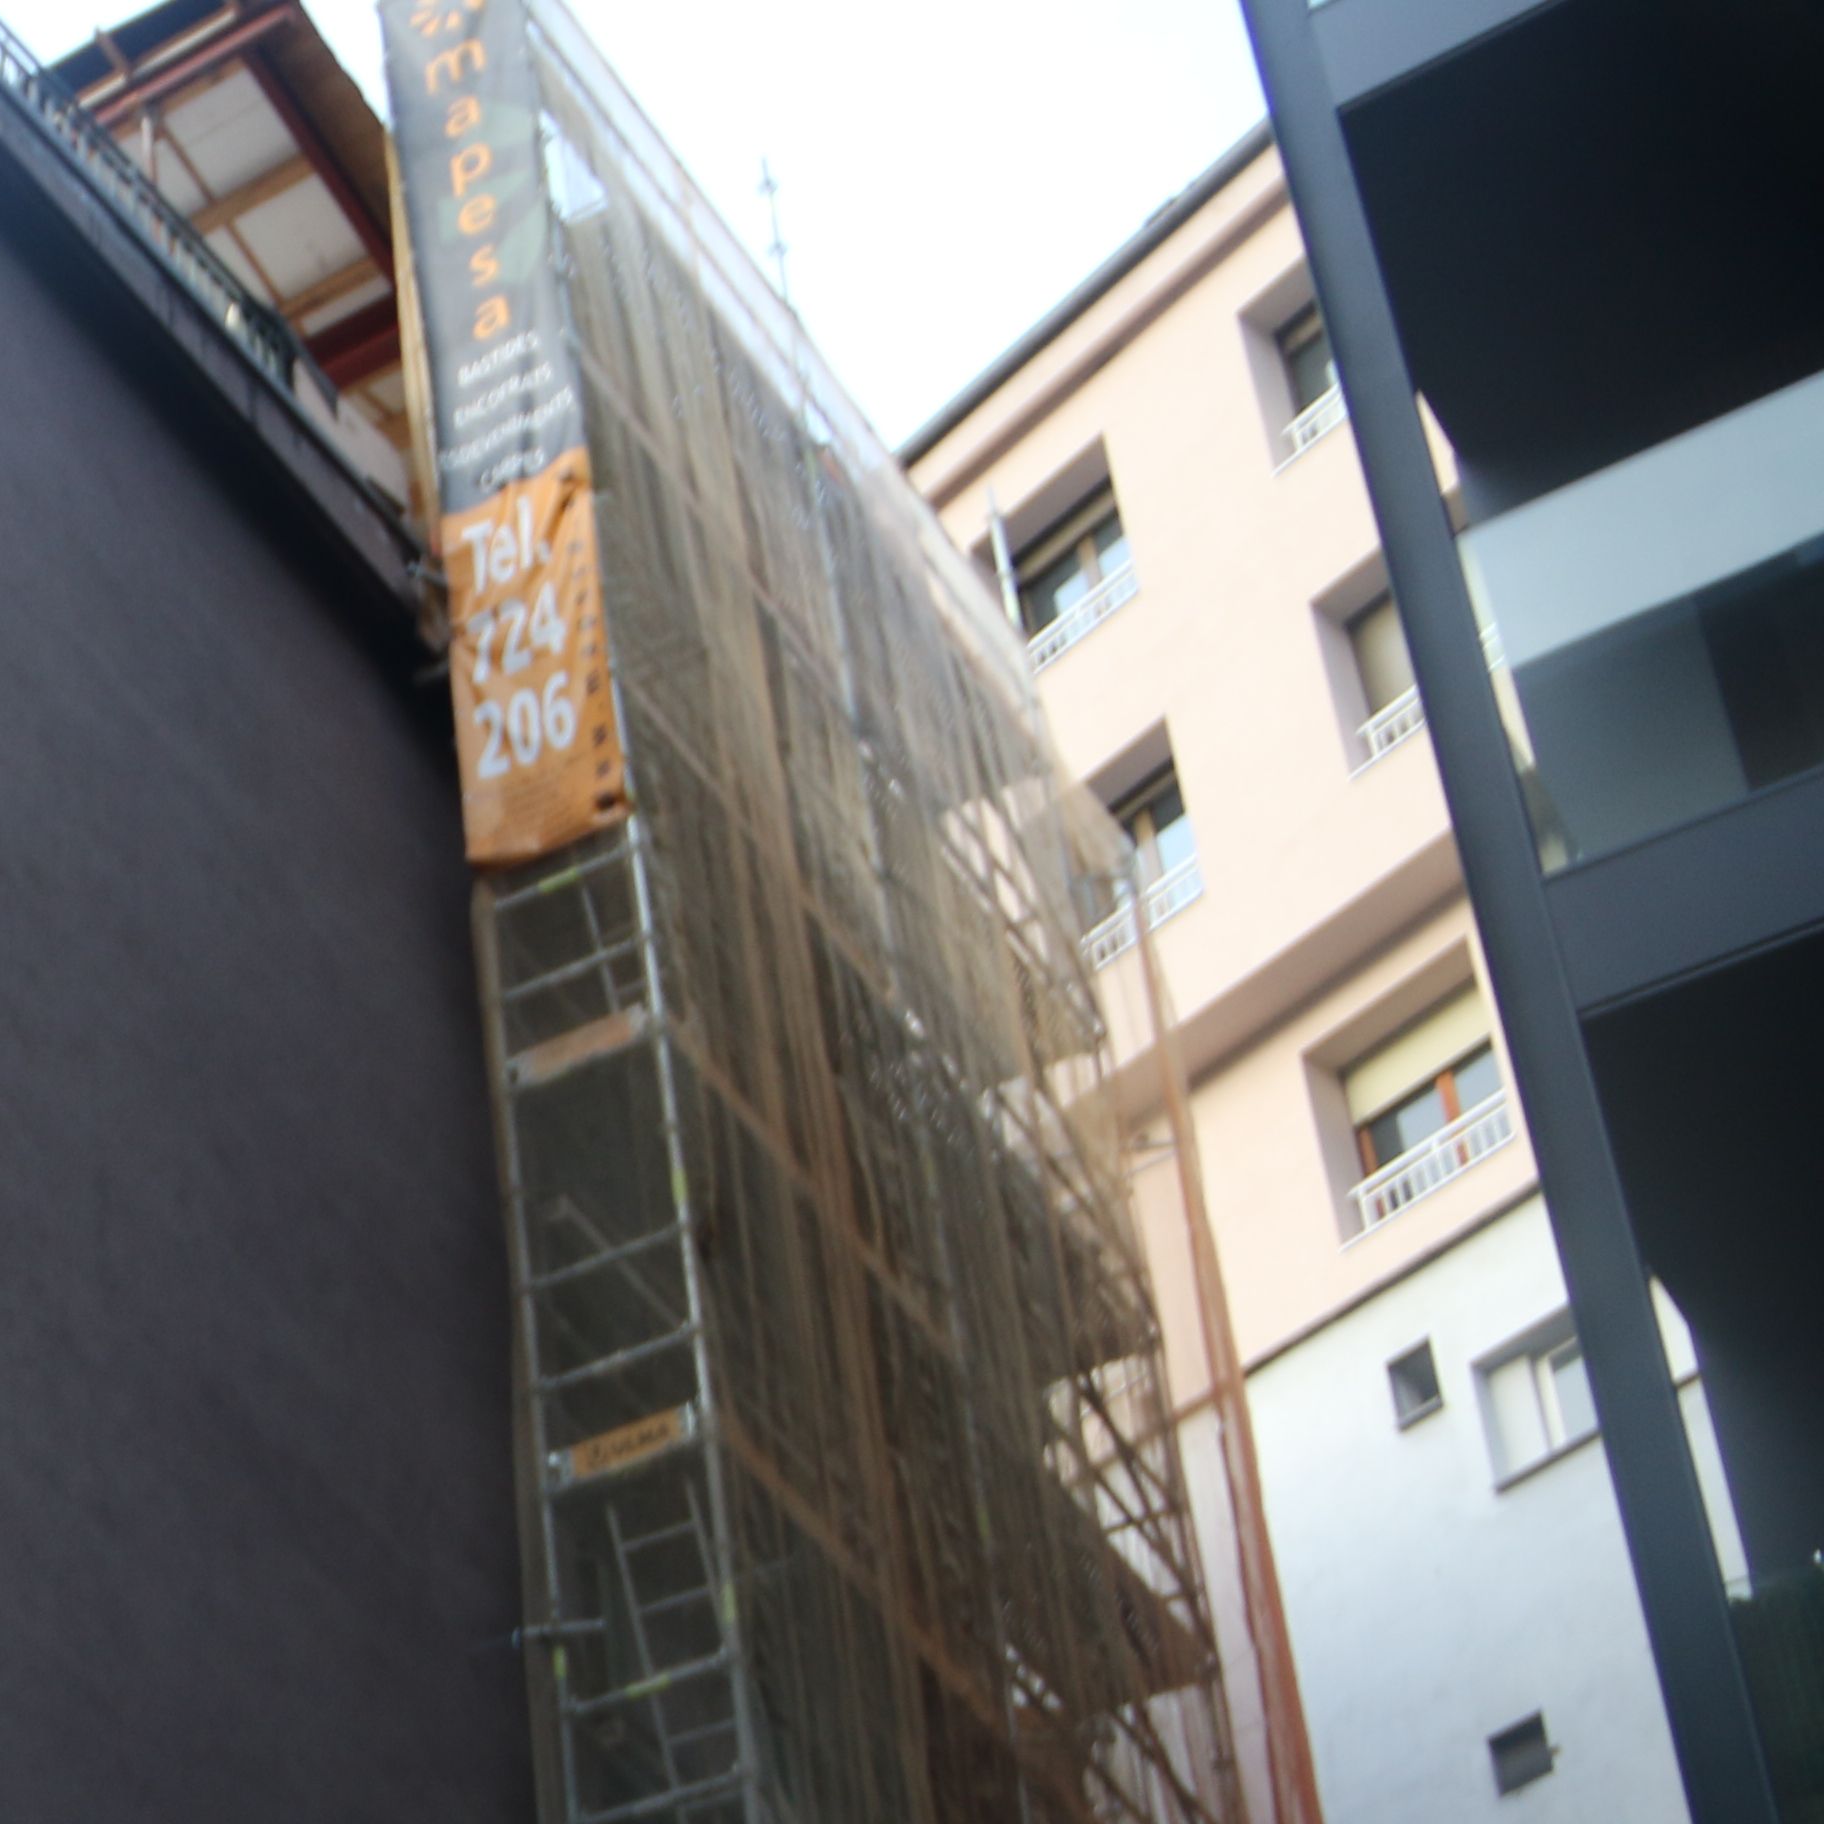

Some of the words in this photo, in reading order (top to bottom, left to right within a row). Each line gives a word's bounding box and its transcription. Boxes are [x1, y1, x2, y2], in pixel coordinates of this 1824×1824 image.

[424, 37, 510, 341] mapesa
[462, 496, 551, 595] Tel.
[466, 581, 566, 686] 724
[473, 671, 576, 781] 206
